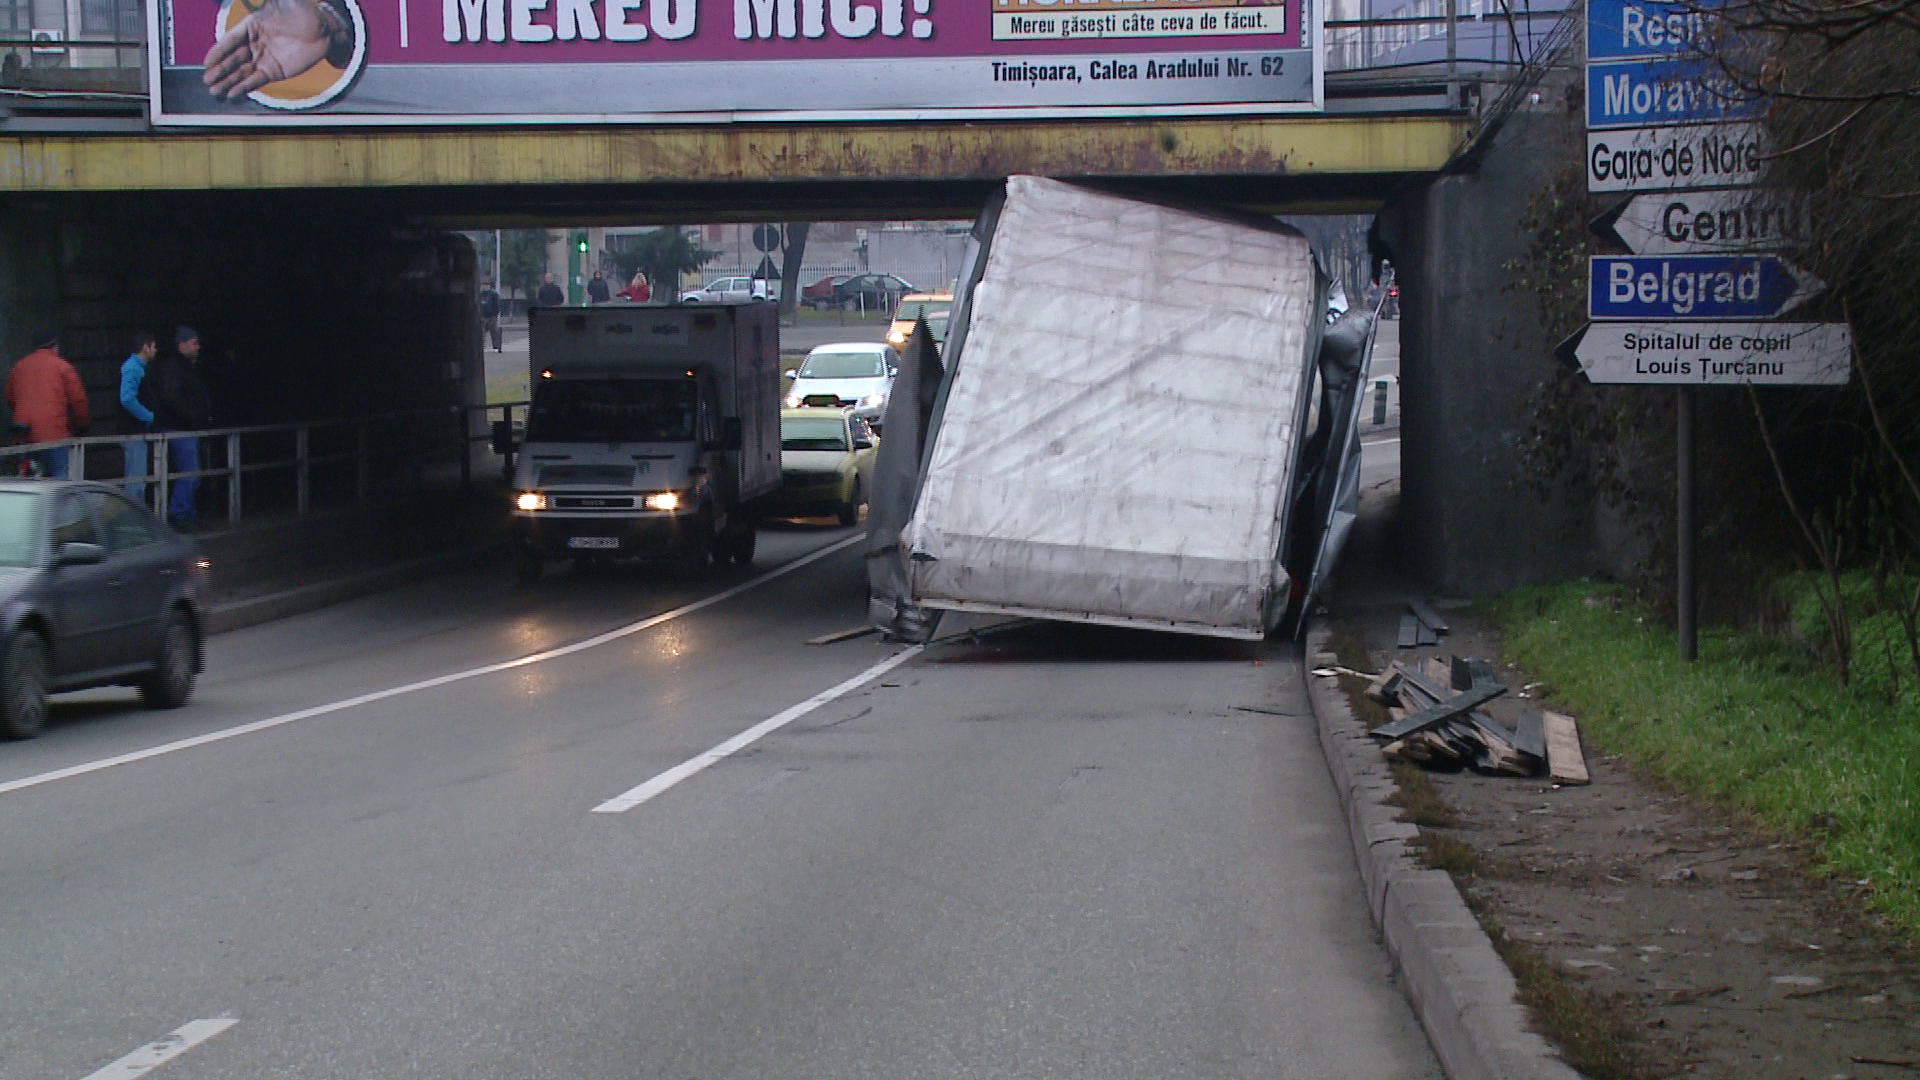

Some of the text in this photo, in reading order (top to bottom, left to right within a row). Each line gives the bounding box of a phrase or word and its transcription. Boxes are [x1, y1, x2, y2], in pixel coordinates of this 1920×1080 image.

[1010, 16, 1055, 34] Mereu
[1122, 14, 1155, 32] câte
[1161, 15, 1194, 31] ceva
[1200, 12, 1217, 30] de
[1224, 12, 1268, 29] făcut.
[1090, 60, 1138, 80] Calea
[1146, 58, 1219, 79] Aradului
[1227, 57, 1252, 77] Nr.
[1260, 56, 1284, 76] 62
[1591, 133, 1760, 181] Gara de Nord
[1609, 261, 1760, 314] Belgrad
[1624, 333, 1700, 353] Spitalul
[1708, 334, 1734, 350] de
[1636, 358, 1691, 374] Louis
